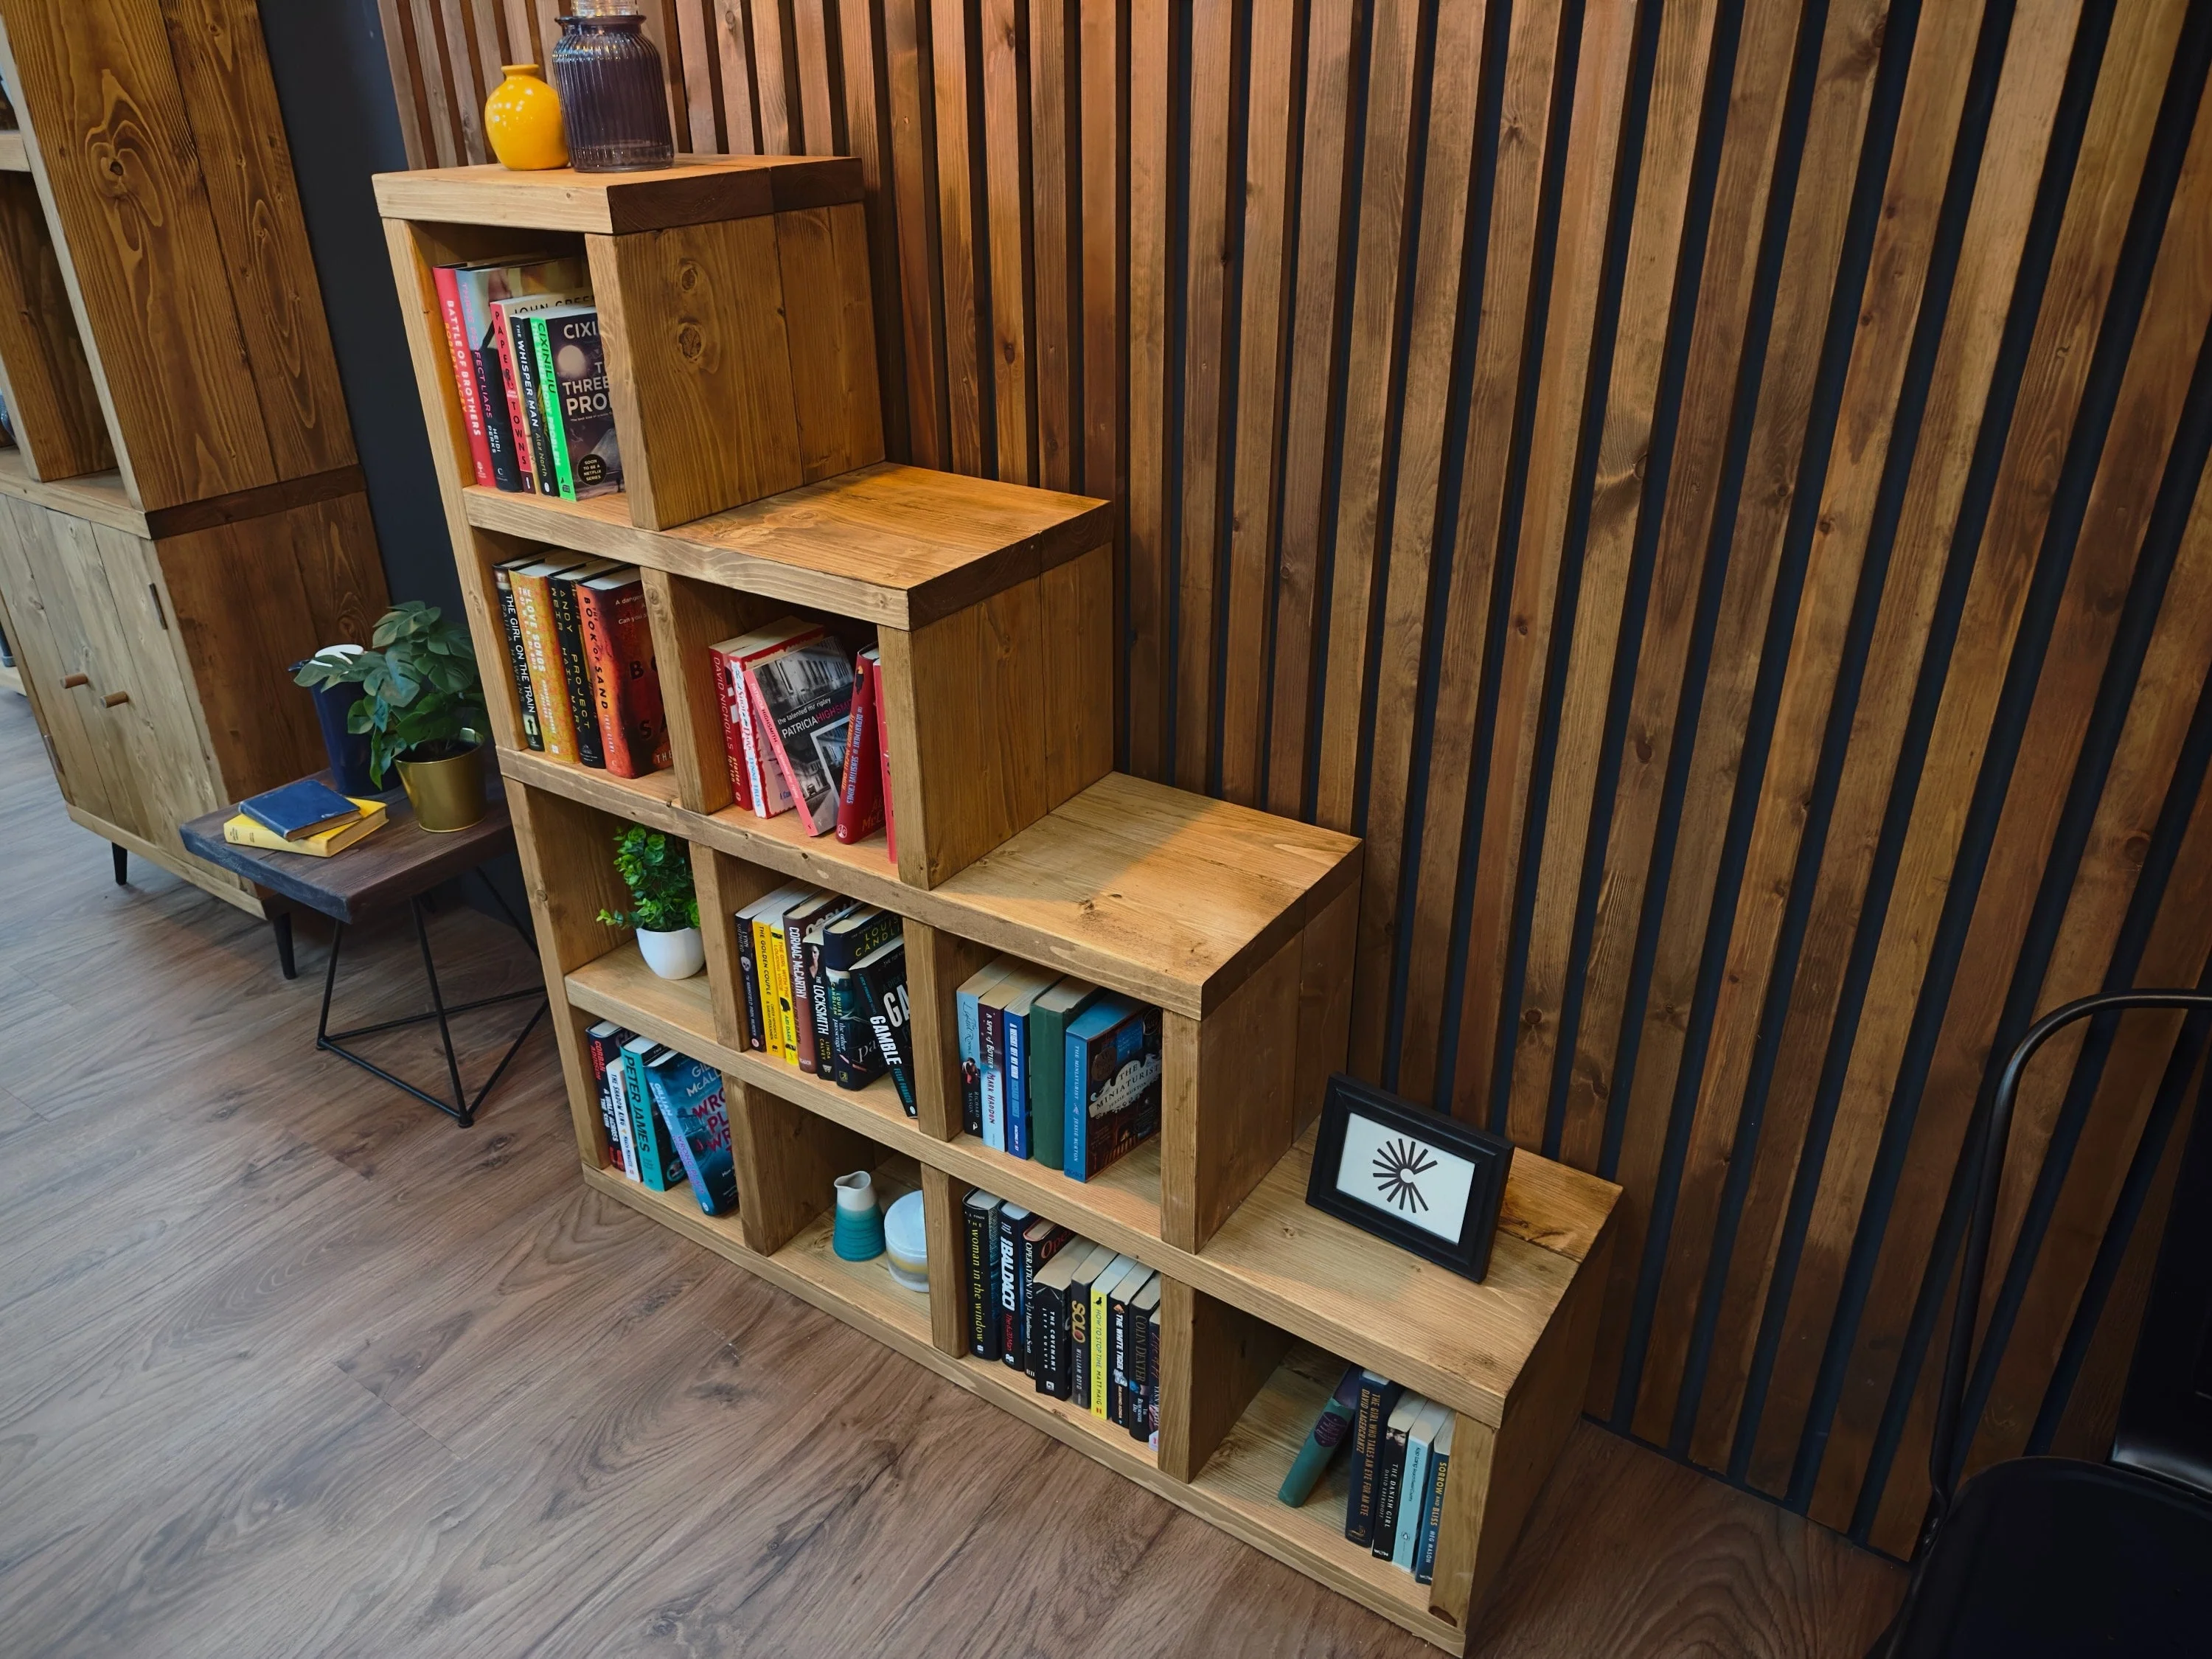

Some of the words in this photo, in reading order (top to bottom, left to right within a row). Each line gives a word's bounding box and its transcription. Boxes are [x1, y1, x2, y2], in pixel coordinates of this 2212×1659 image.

[563, 321, 597, 339] CIXI
[447, 300, 463, 347] BATTLE
[457, 351, 467, 367] OF
[462, 371, 481, 437] BROTHERS
[538, 323, 552, 364] CIXIN
[546, 370, 556, 394] LIU
[455, 375, 467, 413] LACEY
[518, 340, 534, 397] WHISPER
[528, 400, 539, 428] MAN
[562, 375, 609, 395] THREE
[481, 385, 493, 418] LIARS
[566, 392, 608, 416] PRO
[488, 425, 497, 453] PERKS
[493, 428, 501, 453] HEIDI
[511, 401, 526, 465] TOWNS
[506, 594, 516, 614] THE
[526, 598, 538, 629] LOVE
[552, 587, 563, 631] WEIR
[560, 590, 573, 633] ANDY
[510, 618, 521, 641] GIRL
[584, 597, 597, 642] BOOK
[516, 644, 525, 660] ON
[593, 647, 600, 662] OF
[519, 663, 530, 681] THE
[524, 684, 535, 713] TRAIN
[562, 647, 572, 685] HAIL
[571, 695, 582, 733] MARY
[571, 653, 590, 728] PROJECT
[595, 665, 608, 709] SAND
[714, 656, 724, 691] DAVID
[720, 693, 734, 750] NICHOLLS
[750, 683, 764, 709] PATRICIA
[761, 709, 777, 743] HIGHSMITH
[777, 717, 787, 726] the
[786, 706, 808, 720] talented
[816, 698, 832, 708] ripley
[782, 715, 818, 739] PATRICIA
[852, 714, 863, 749] DEPARTMENT
[849, 756, 859, 784] SENSITIVE
[846, 783, 855, 804] CRIMES
[761, 940, 769, 969] GOLDEN
[789, 926, 803, 959] CORMAC
[764, 970, 772, 995] COUPLE
[792, 960, 807, 999] McCARTHY
[813, 984, 829, 1035] LOCKSMITH
[869, 1015, 902, 1067] GAMBLE
[986, 1037, 994, 1045] of
[591, 1046, 602, 1080] ADDISON
[594, 1040, 605, 1072] CORBAN
[987, 1044, 995, 1069] BOTHER
[894, 1068, 903, 1085] FELIX
[987, 1072, 995, 1093] MARK
[1119, 1063, 1138, 1079] THE
[655, 1082, 672, 1116] GILLIAN
[898, 1084, 913, 1105] FRANCIS
[1096, 1064, 1159, 1110] MINIATURIST
[613, 1086, 624, 1110] SHADOW
[619, 1111, 627, 1127] KING
[625, 1054, 641, 1103] PETER
[634, 1106, 650, 1152] JAMES
[609, 1118, 619, 1142] ACROSS
[678, 1135, 695, 1166] WRONG
[967, 1220, 982, 1228] THE
[973, 1269, 984, 1280] in
[1001, 1236, 1015, 1311] BALDACCI
[974, 1283, 985, 1299] the
[975, 1303, 986, 1342] window
[1072, 1300, 1085, 1343] SOLO
[1096, 1327, 1102, 1336] TO
[1116, 1314, 1124, 1329] THE
[1135, 1315, 1147, 1343] COLIN
[1116, 1329, 1124, 1351] WHITE
[1135, 1345, 1147, 1385] DEXTER
[1360, 1388, 1370, 1410] DAVID
[1371, 1394, 1380, 1407] THE
[1370, 1408, 1379, 1422] GIRL
[1357, 1409, 1368, 1454] LAGERCRANTZ
[1368, 1424, 1377, 1439] WHO
[1366, 1439, 1376, 1458] TAKES
[1364, 1468, 1373, 1481] EYE
[1365, 1458, 1374, 1469] AN
[1391, 1463, 1399, 1478] THE
[1363, 1481, 1371, 1494] FOR
[1436, 1461, 1447, 1495] SORROW
[1361, 1494, 1371, 1504] AN
[1379, 1488, 1388, 1519] EBERSHOFF
[1388, 1480, 1397, 1510] DANISH
[1360, 1504, 1369, 1517] EYE
[1430, 1507, 1440, 1526] BLISS
